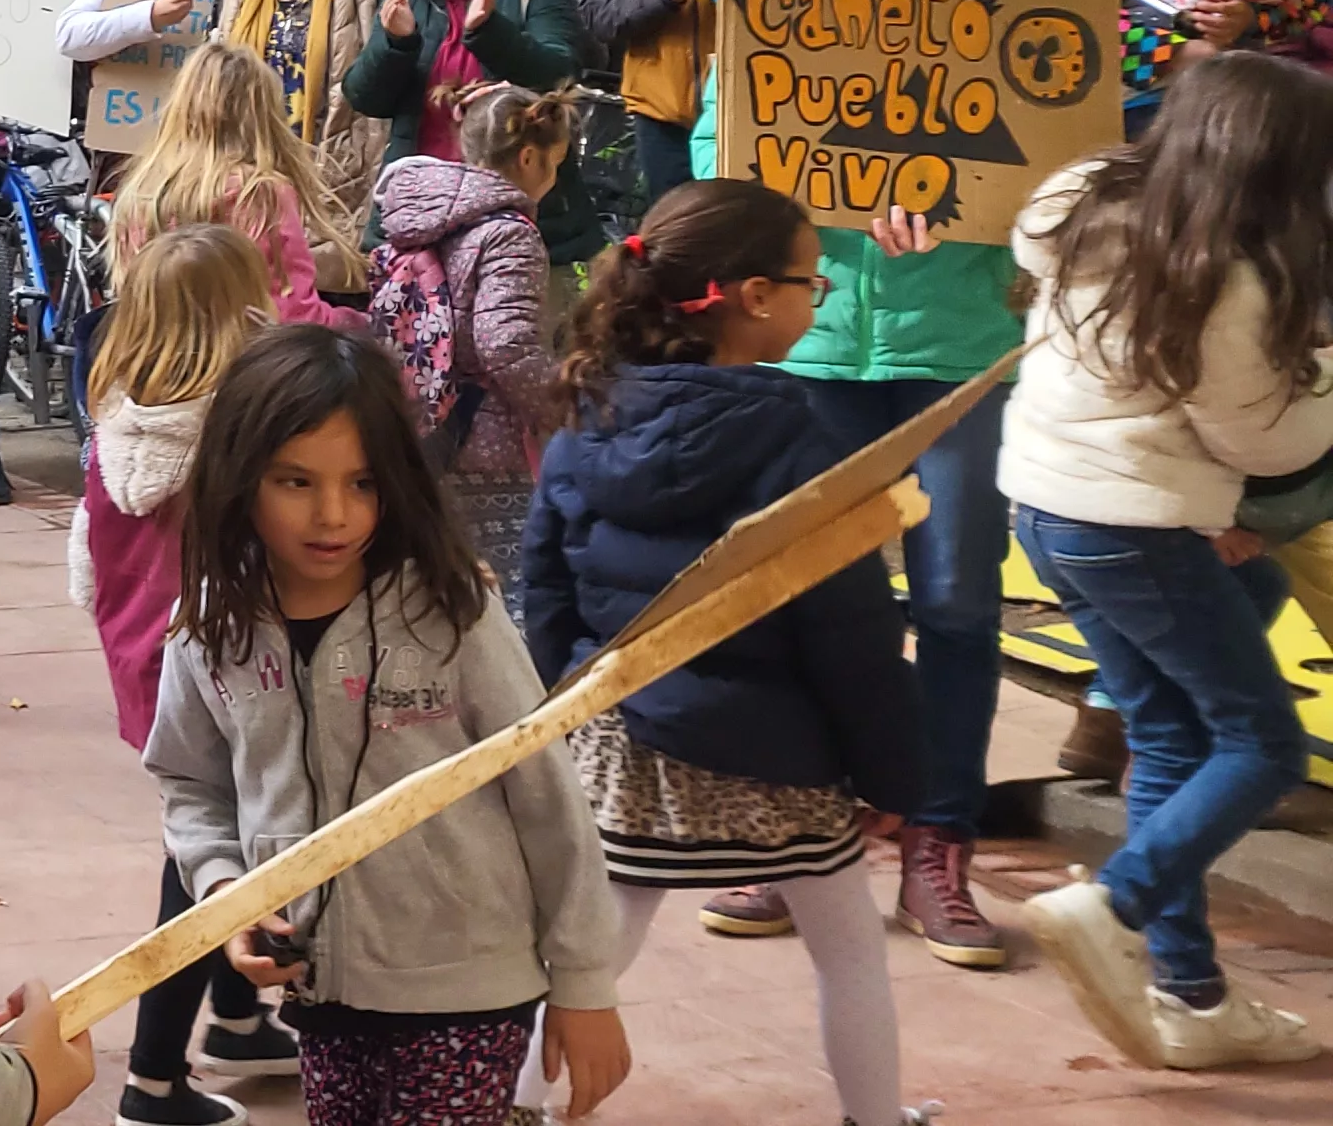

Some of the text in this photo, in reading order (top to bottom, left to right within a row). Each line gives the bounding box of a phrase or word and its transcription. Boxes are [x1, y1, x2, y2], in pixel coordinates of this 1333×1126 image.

[103, 88, 144, 125] ES
[746, 49, 999, 136] Pueblo
[753, 132, 959, 218] Vivo
